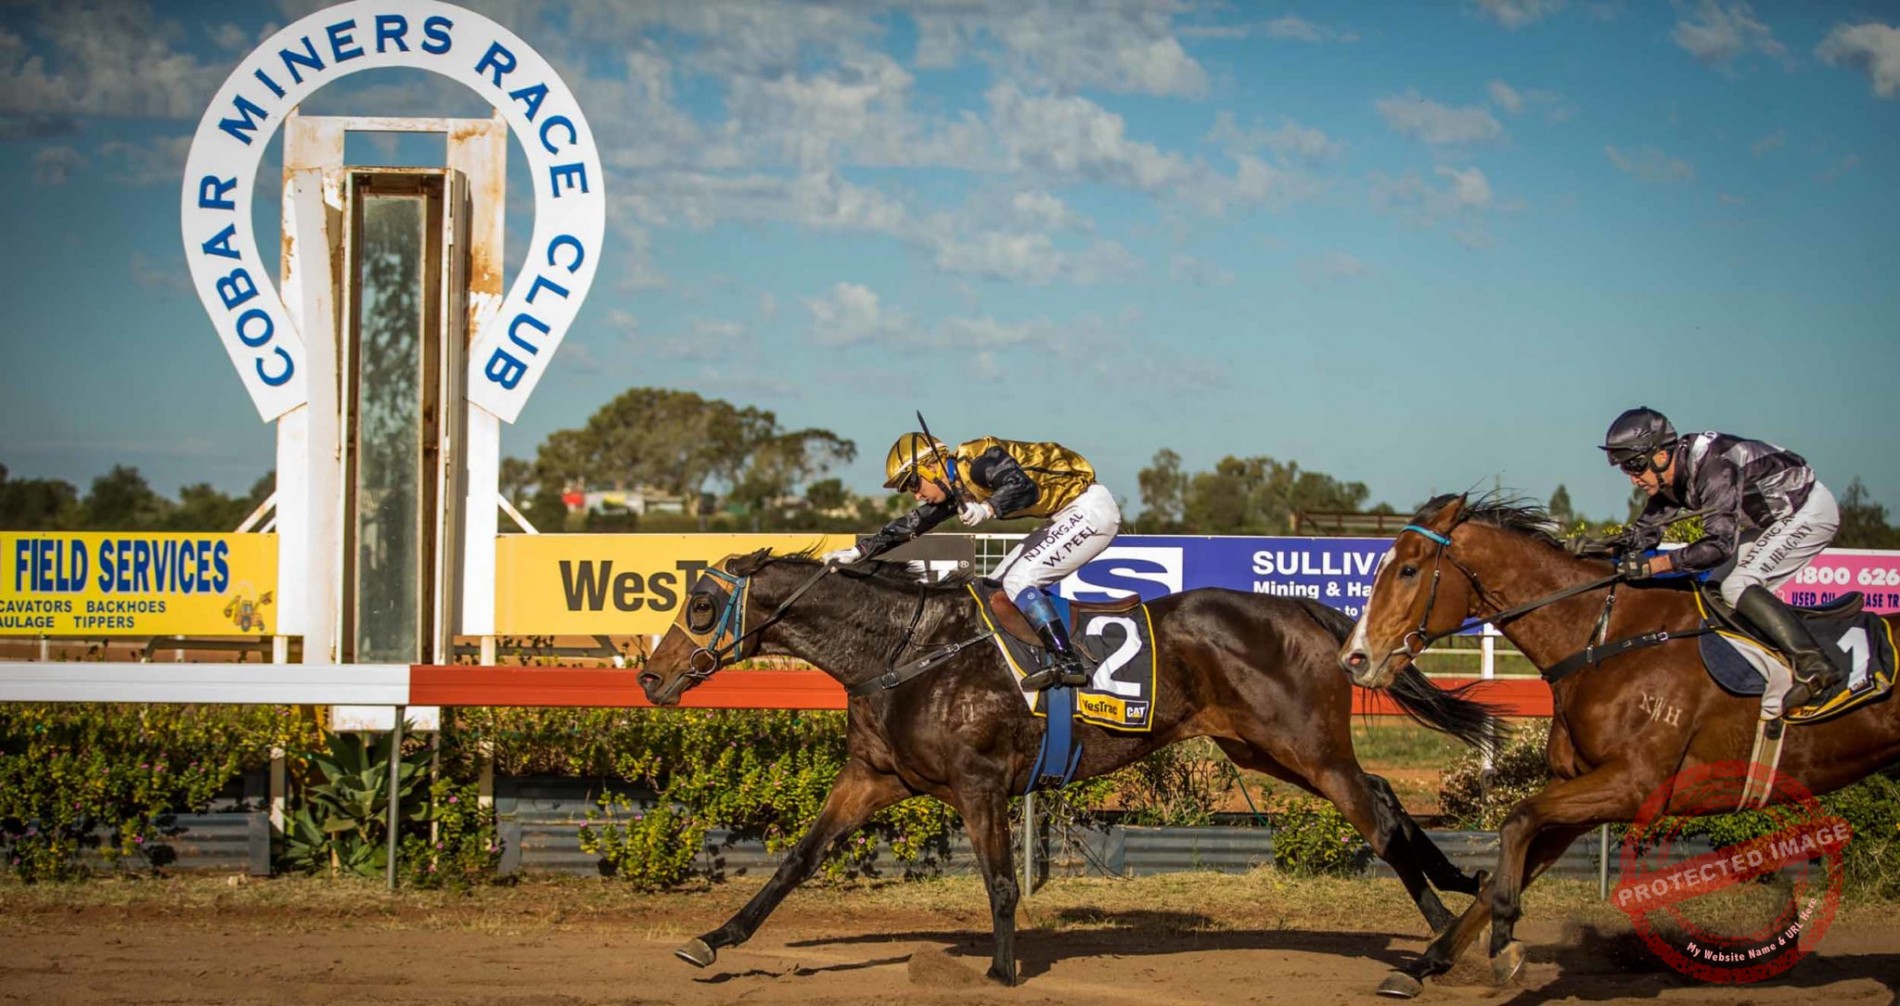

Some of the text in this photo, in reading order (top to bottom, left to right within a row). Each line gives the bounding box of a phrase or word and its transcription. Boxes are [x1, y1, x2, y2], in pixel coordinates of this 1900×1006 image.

[199, 14, 589, 390] COBAR MINERS RACE CLUB
[1042, 526, 1098, 567] W. PEEL
[15, 539, 229, 594] FIELD SERVICES
[1252, 550, 1385, 575] SULLIV
[1795, 566, 1900, 586] 1800 626
[1253, 581, 1320, 600] Mining
[1325, 581, 1342, 597] &
[1792, 591, 1817, 606] USED
[1862, 593, 1883, 608] ASE
[86, 600, 166, 613] BACKHOES
[74, 616, 134, 629] TIPPERS
[1086, 616, 1143, 697] 2
[1836, 626, 1870, 690] 1
[1126, 706, 1146, 719] CAT
